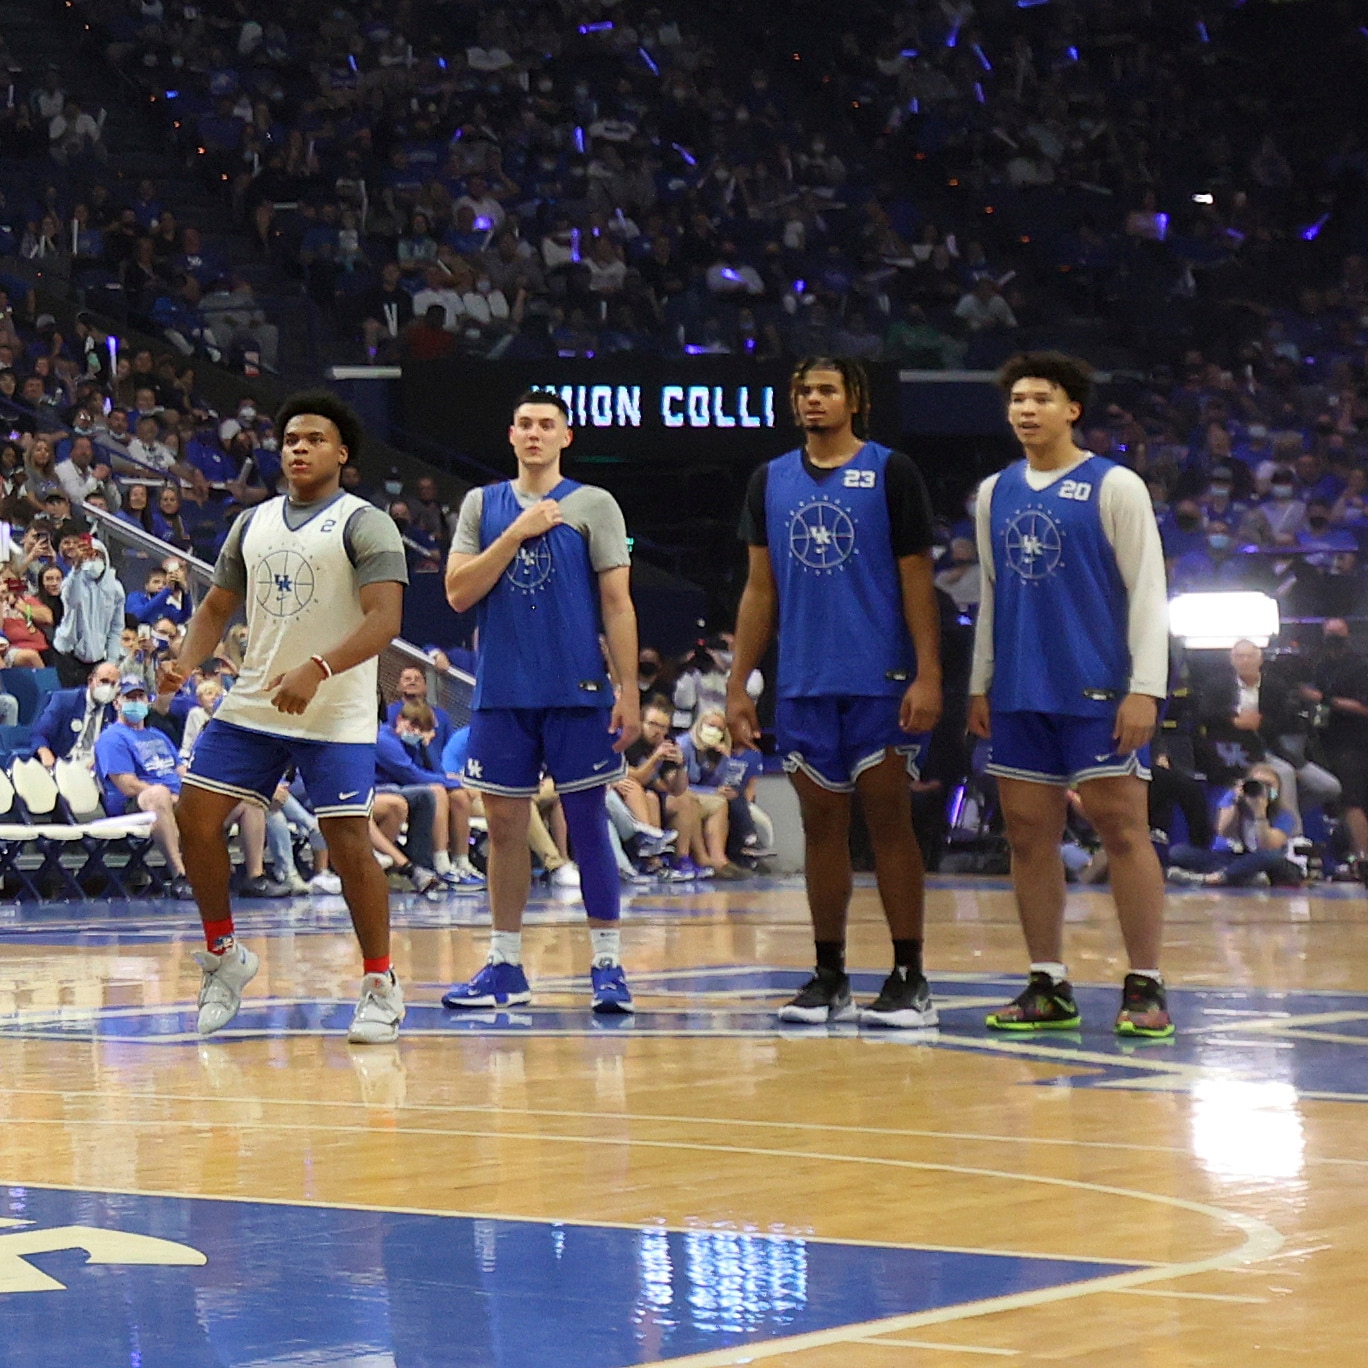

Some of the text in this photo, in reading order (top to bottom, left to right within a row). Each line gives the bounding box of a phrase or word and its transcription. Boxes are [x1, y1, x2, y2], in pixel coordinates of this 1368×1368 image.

[843, 469, 876, 489] 23
[1058, 479, 1093, 502] 20
[320, 519, 337, 533] 2
[273, 574, 293, 593] UK
[467, 757, 484, 780] UK
